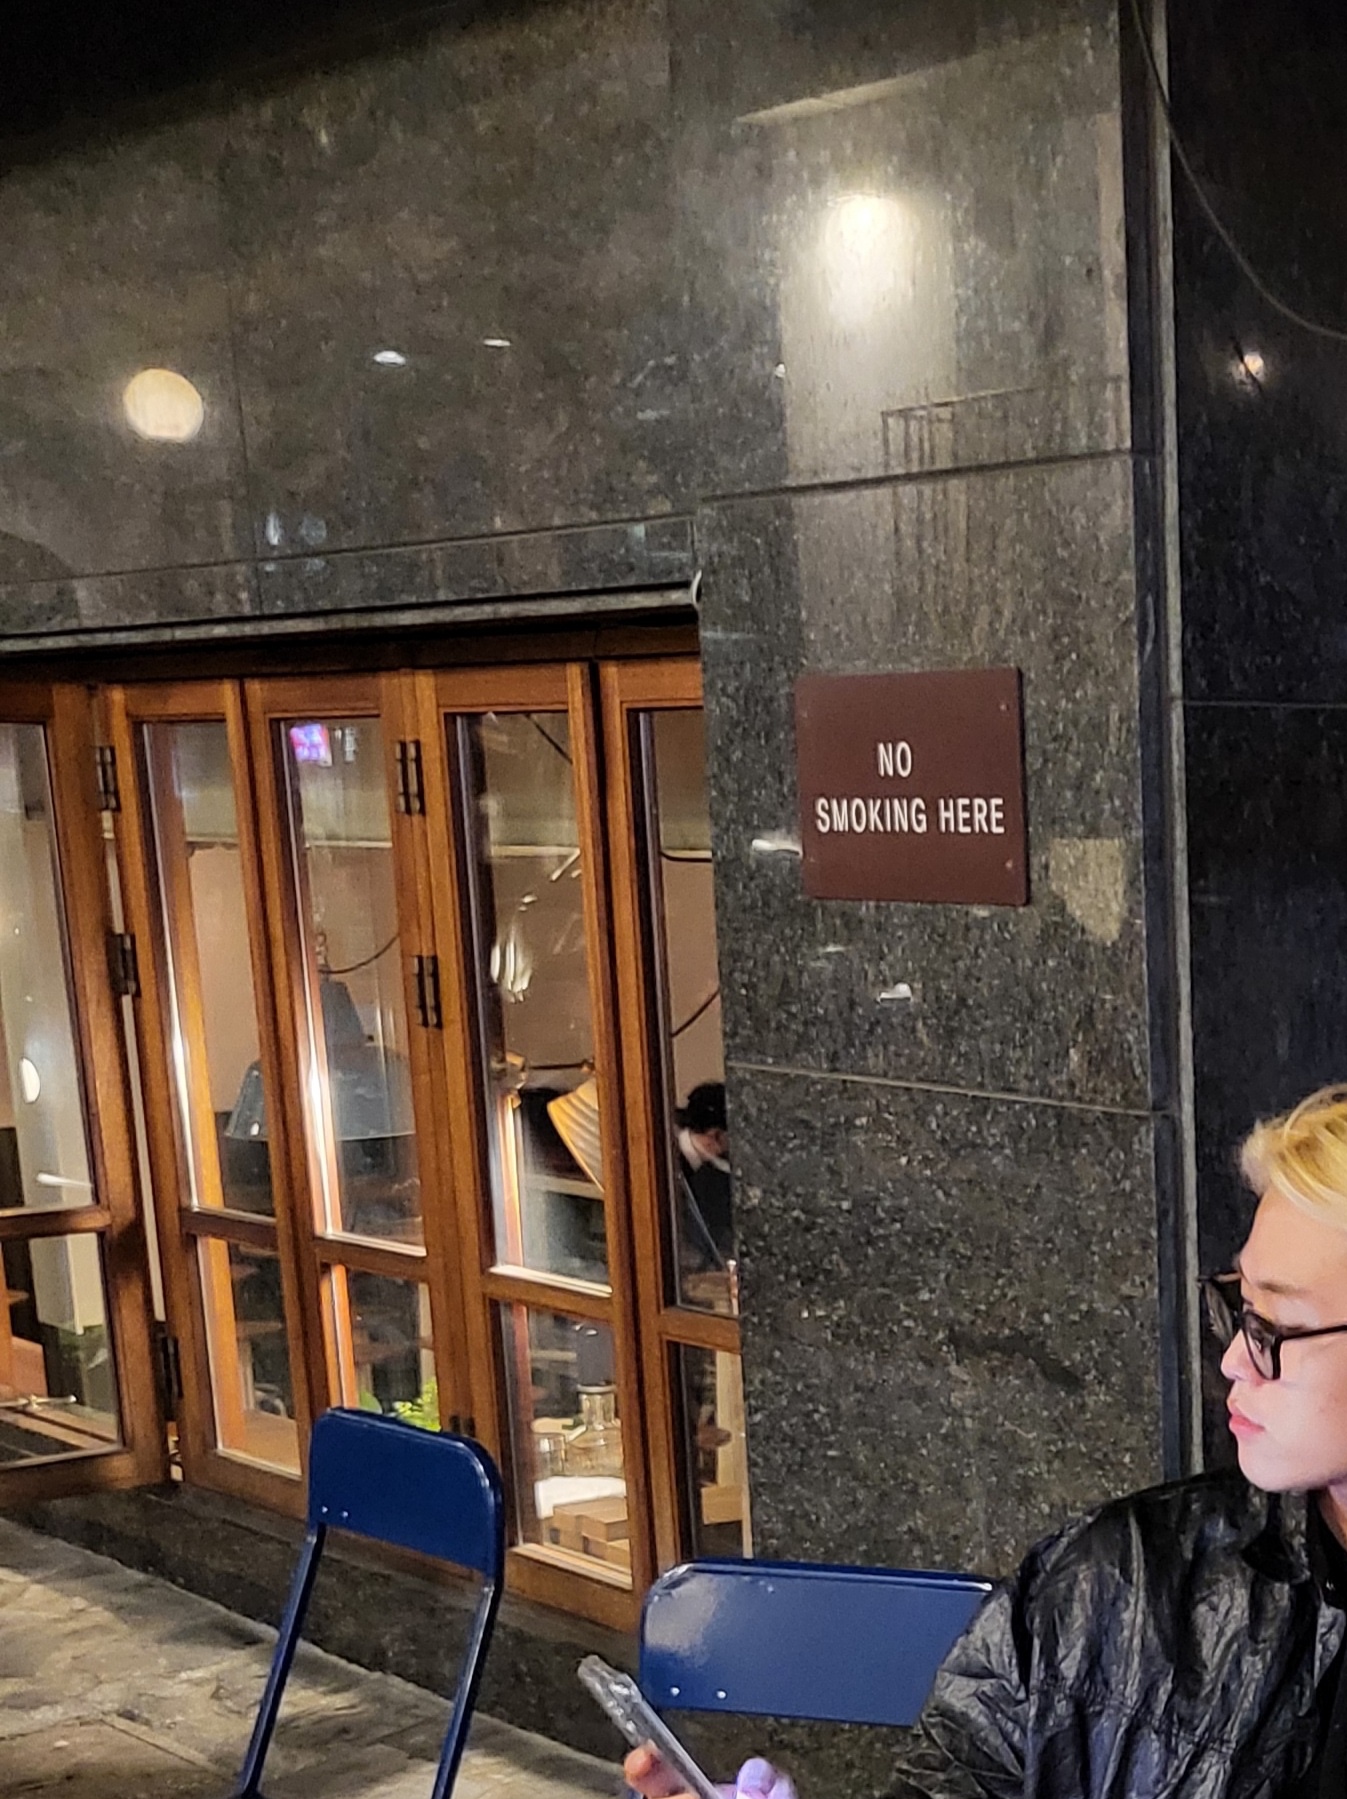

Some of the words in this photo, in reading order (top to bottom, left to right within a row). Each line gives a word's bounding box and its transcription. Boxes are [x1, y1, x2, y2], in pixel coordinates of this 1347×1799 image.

[877, 741, 912, 777] NO
[815, 797, 927, 833] SMOKING
[938, 797, 1005, 834] HERE
